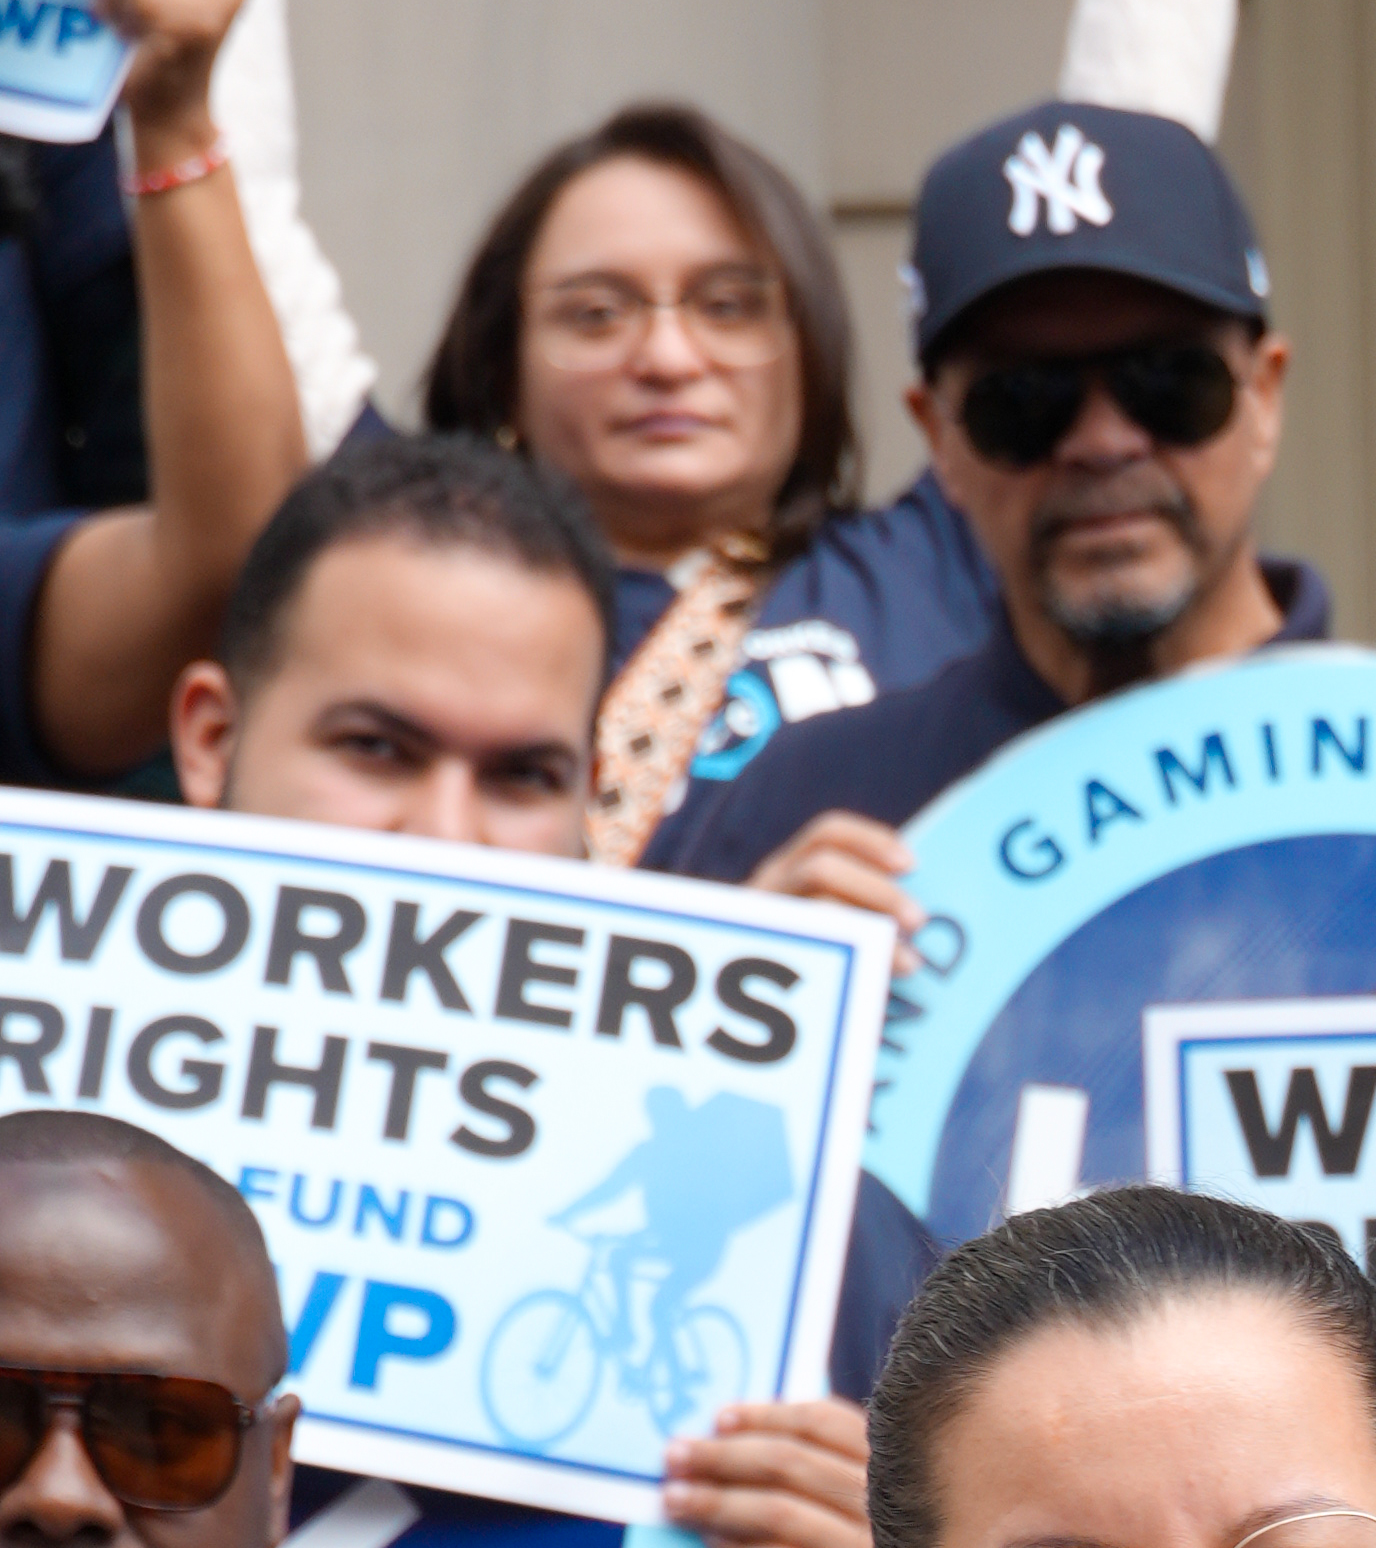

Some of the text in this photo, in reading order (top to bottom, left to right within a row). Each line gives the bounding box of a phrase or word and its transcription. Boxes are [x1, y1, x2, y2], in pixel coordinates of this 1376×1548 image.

[1003, 123, 1113, 235] NY
[0, 855, 803, 1066] WORKERS
[0, 997, 542, 1163] RIGHTS
